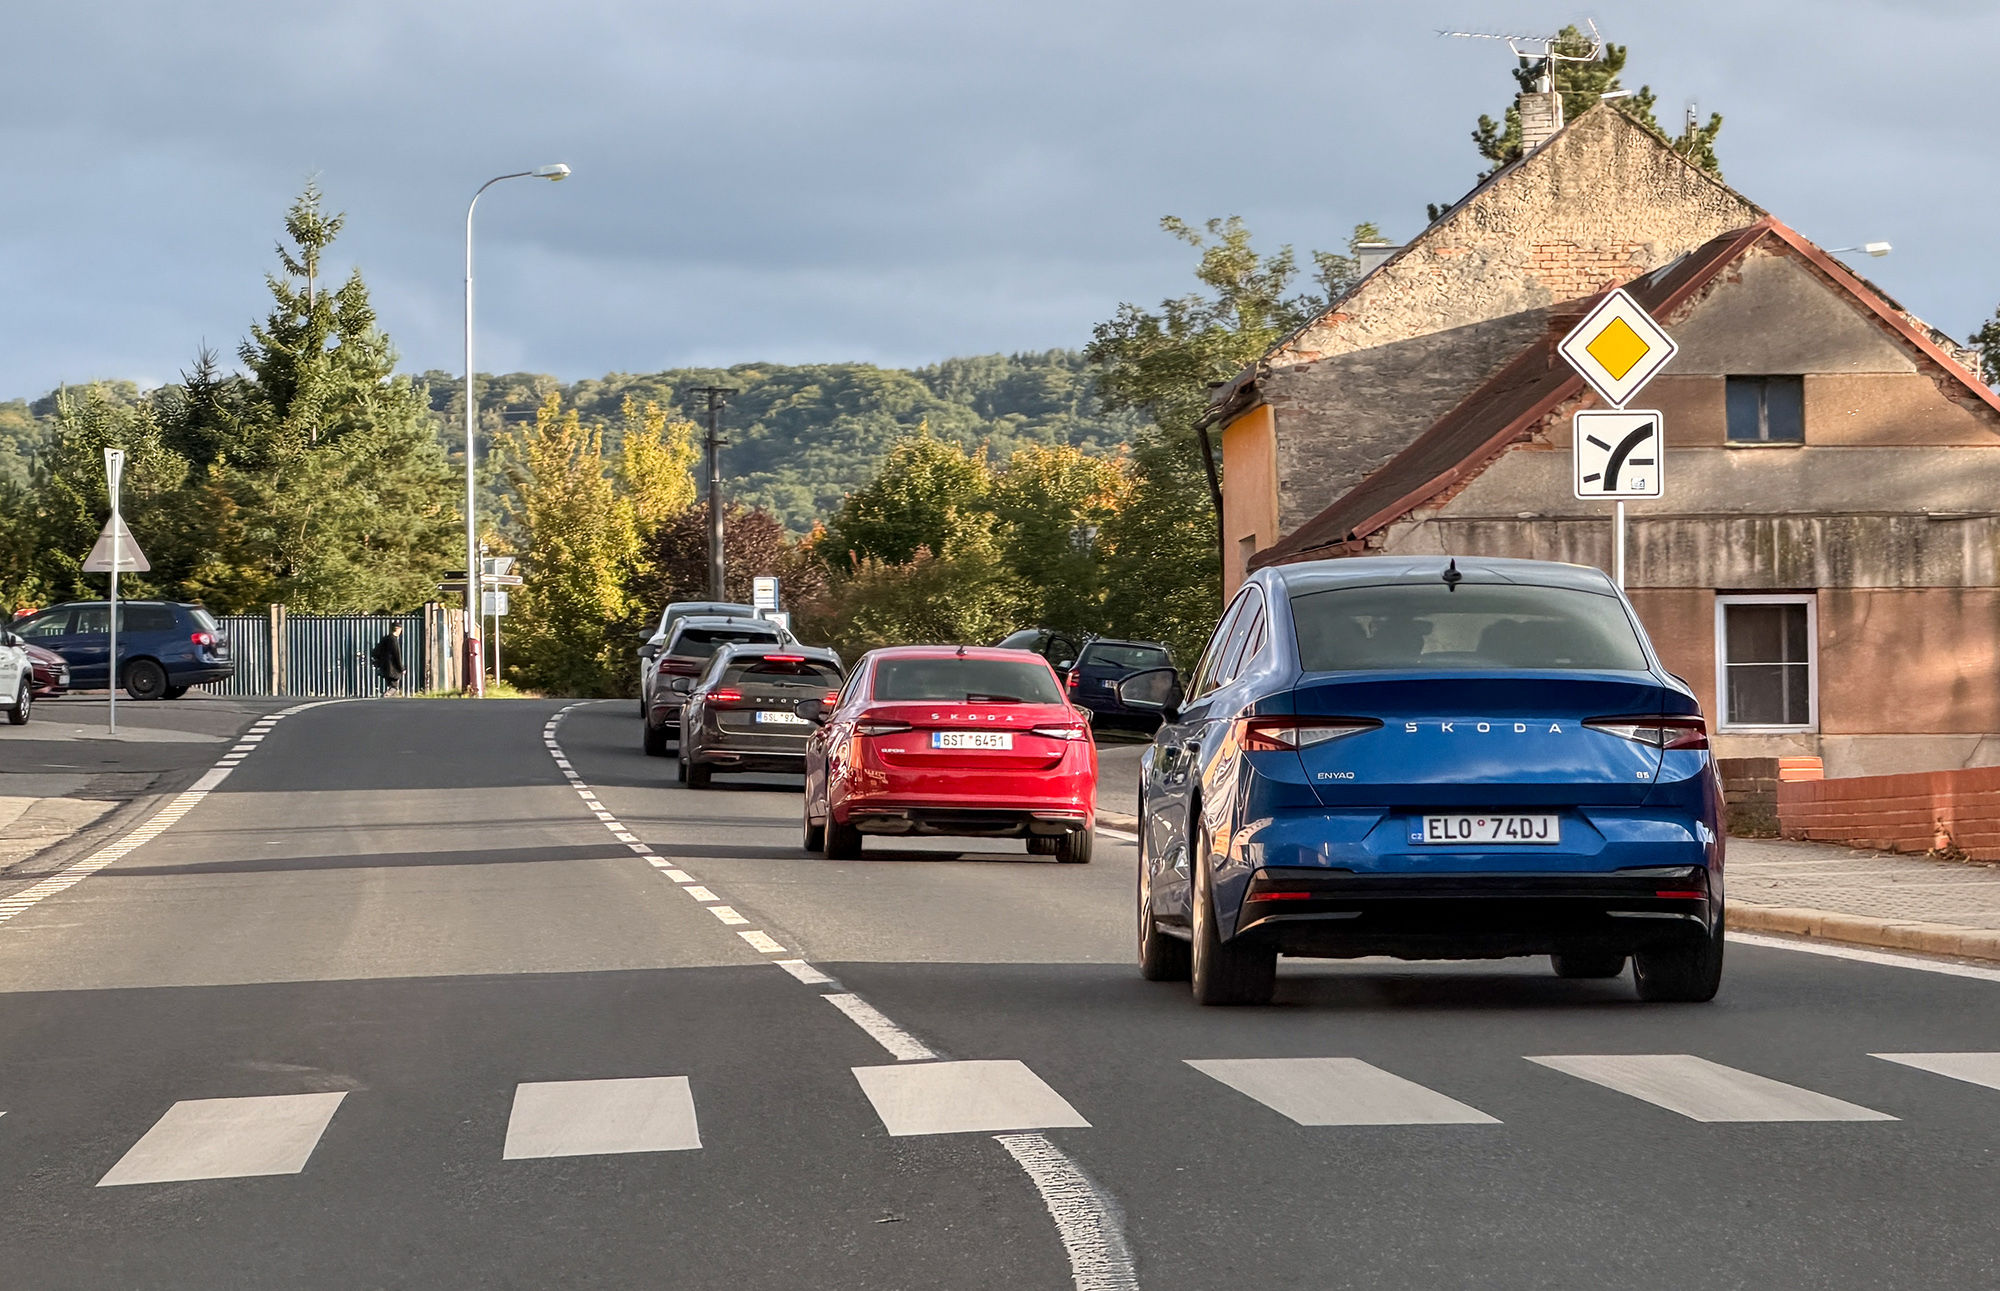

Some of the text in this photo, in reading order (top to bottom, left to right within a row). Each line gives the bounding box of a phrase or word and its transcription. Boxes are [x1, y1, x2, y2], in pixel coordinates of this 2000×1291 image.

[943, 734, 965, 747] 6ST
[975, 735, 1004, 748] 6451
[1317, 771, 1355, 780] ENYAQ
[1490, 818, 1548, 840] 74DJ
[1411, 832, 1423, 840] CZ
